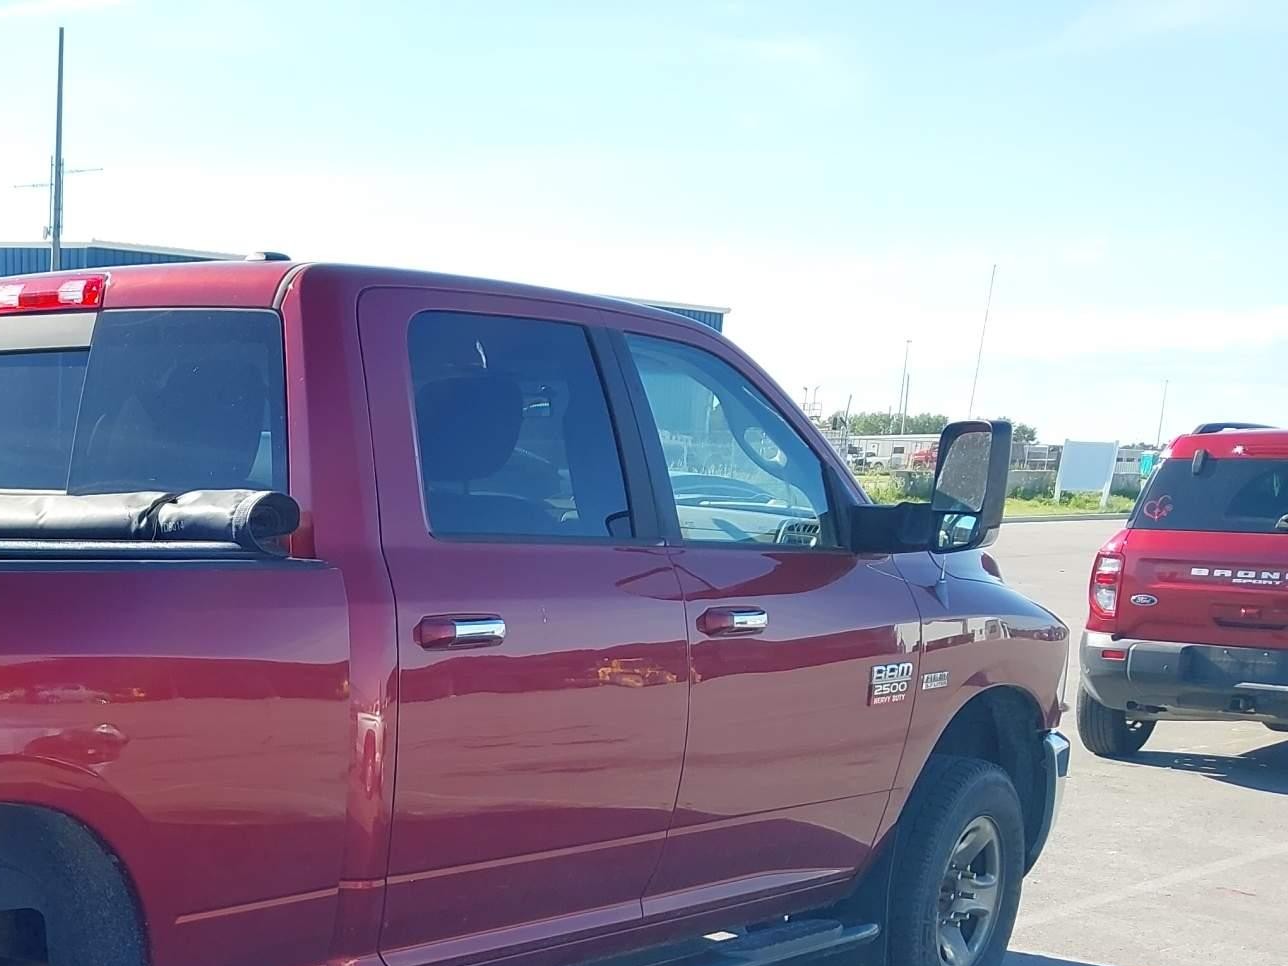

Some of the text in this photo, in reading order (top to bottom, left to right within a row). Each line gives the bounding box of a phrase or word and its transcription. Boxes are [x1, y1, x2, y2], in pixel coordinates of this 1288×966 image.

[1190, 567, 1288, 580] BRON
[872, 663, 913, 682] RAM
[873, 681, 908, 696] 2500
[873, 693, 906, 704] HEAVY DUTY
